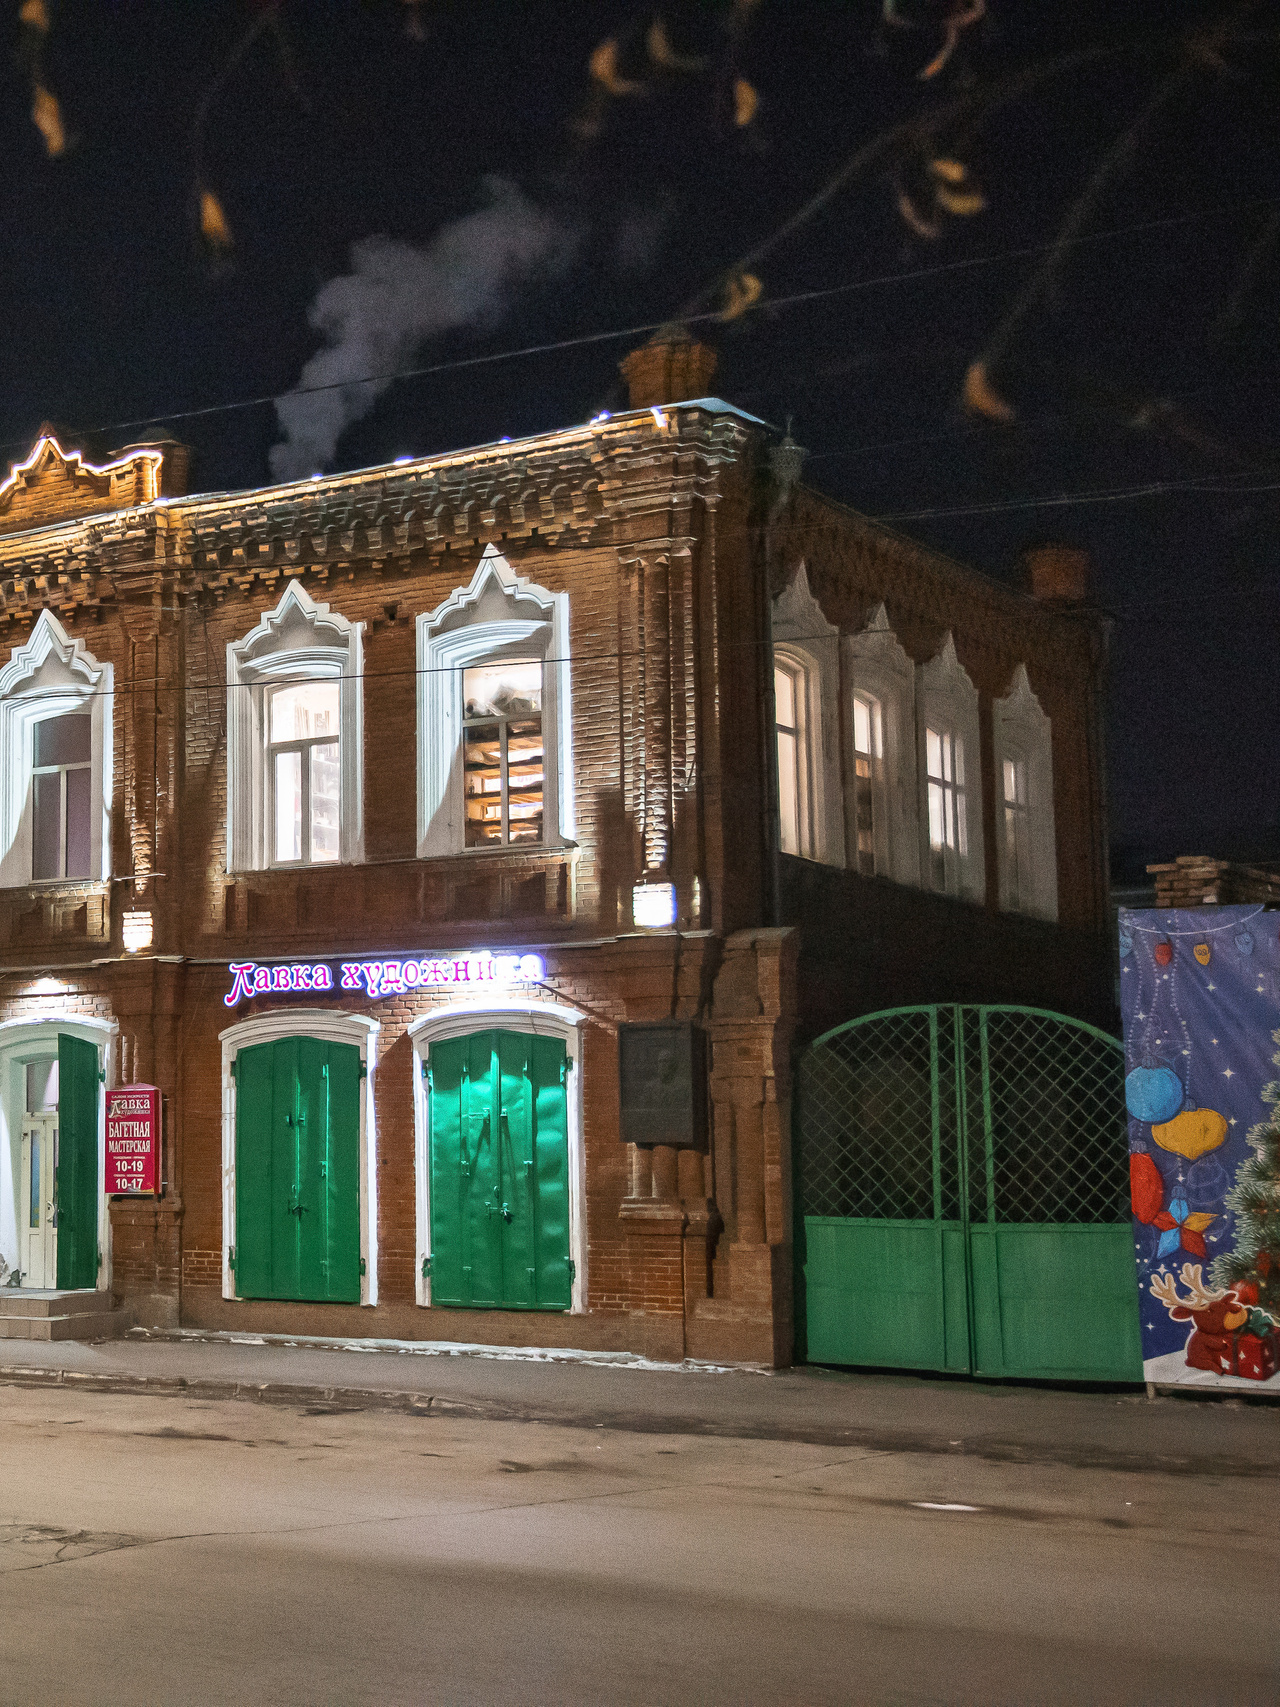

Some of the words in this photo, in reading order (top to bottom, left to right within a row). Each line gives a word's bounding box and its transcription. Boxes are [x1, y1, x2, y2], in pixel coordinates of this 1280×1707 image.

[224, 962, 332, 1006] Лавка
[341, 953, 546, 997] художни
[108, 1099, 151, 1118] Лавка
[108, 1121, 151, 1138] БАГЕТНАЯ
[108, 1140, 151, 1153] МАСТЕРСКАЯ
[115, 1160, 144, 1172] 10-19
[115, 1178, 144, 1190] 10-17
